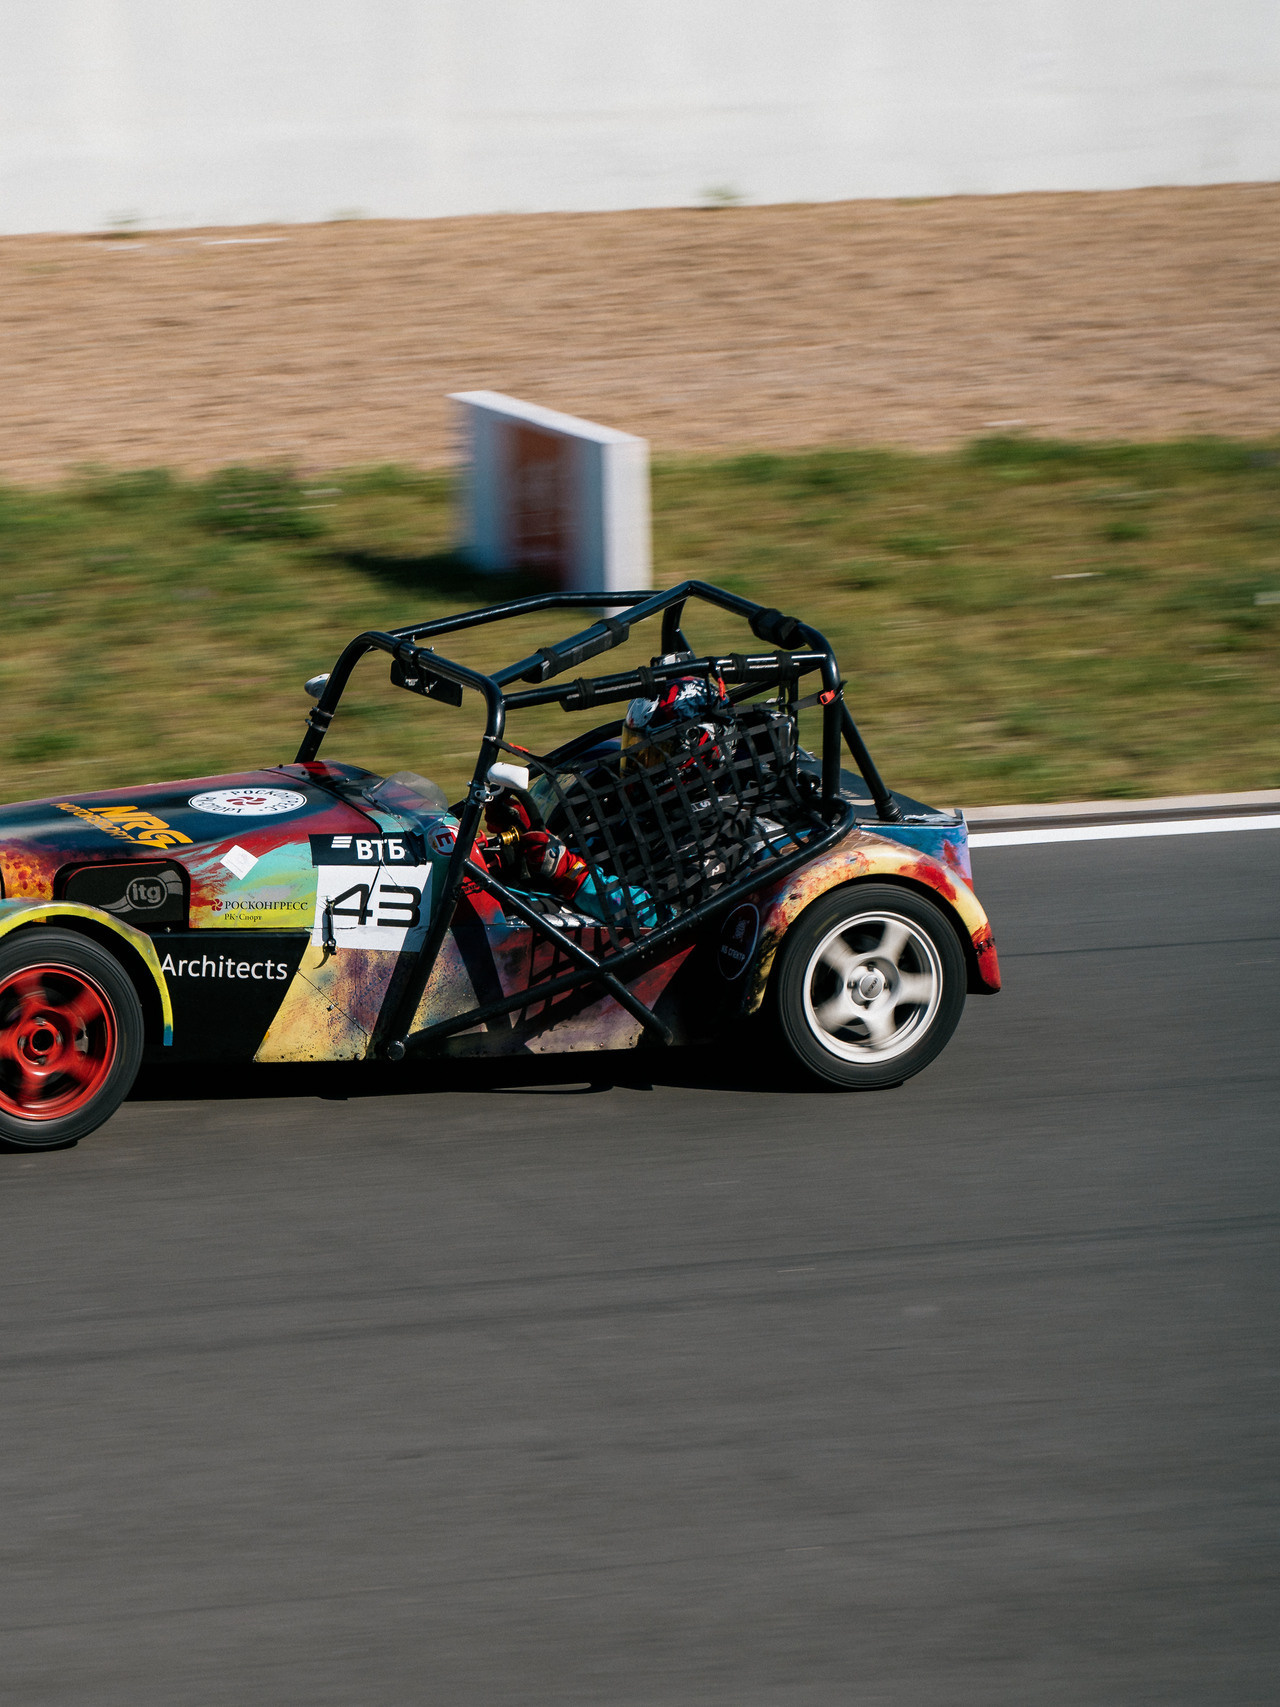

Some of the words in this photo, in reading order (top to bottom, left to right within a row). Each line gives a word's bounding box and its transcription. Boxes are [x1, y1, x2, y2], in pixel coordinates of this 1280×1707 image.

[88, 805, 194, 850] NRG
[356, 839, 406, 860] ВТБ
[132, 882, 161, 904] itg
[224, 900, 309, 911] РОСКОНГРЕСС
[332, 883, 422, 929] 43
[161, 953, 288, 980] Architects
